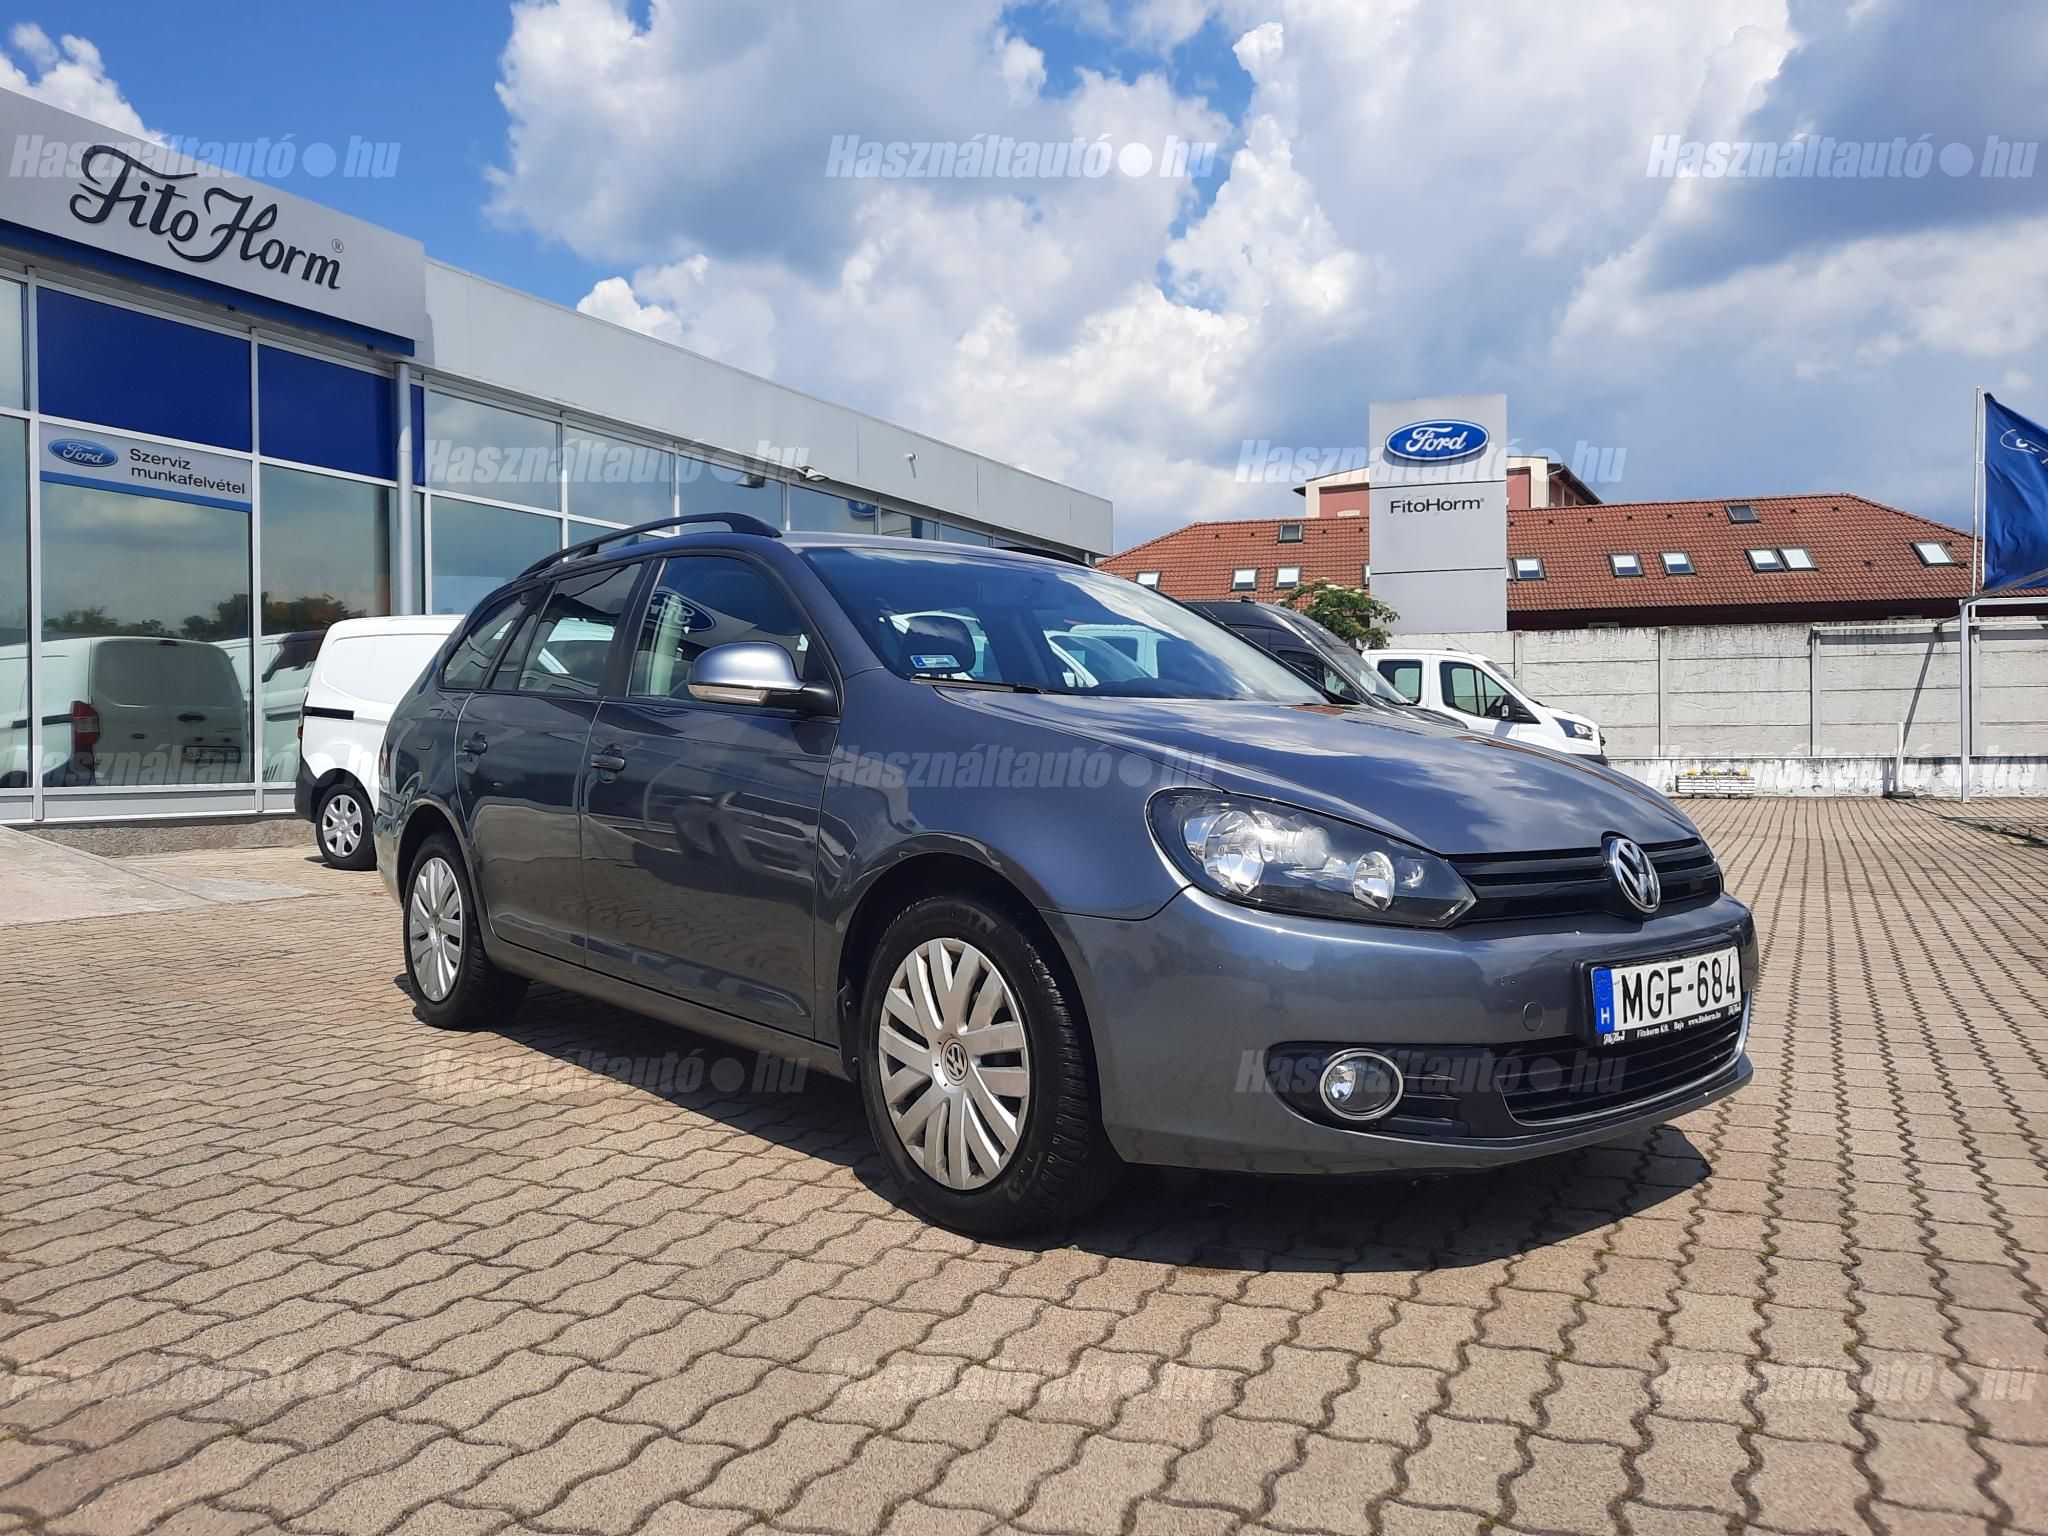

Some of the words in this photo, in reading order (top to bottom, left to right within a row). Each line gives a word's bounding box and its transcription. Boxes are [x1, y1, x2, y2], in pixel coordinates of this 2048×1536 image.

[1405, 426, 1469, 452] Ford
[62, 441, 104, 465] Ford
[129, 448, 191, 470] Szerviz
[131, 466, 246, 495] munkafelvétel
[1620, 954, 1737, 1025] MGF-684
[1600, 1008, 1611, 1025] H
